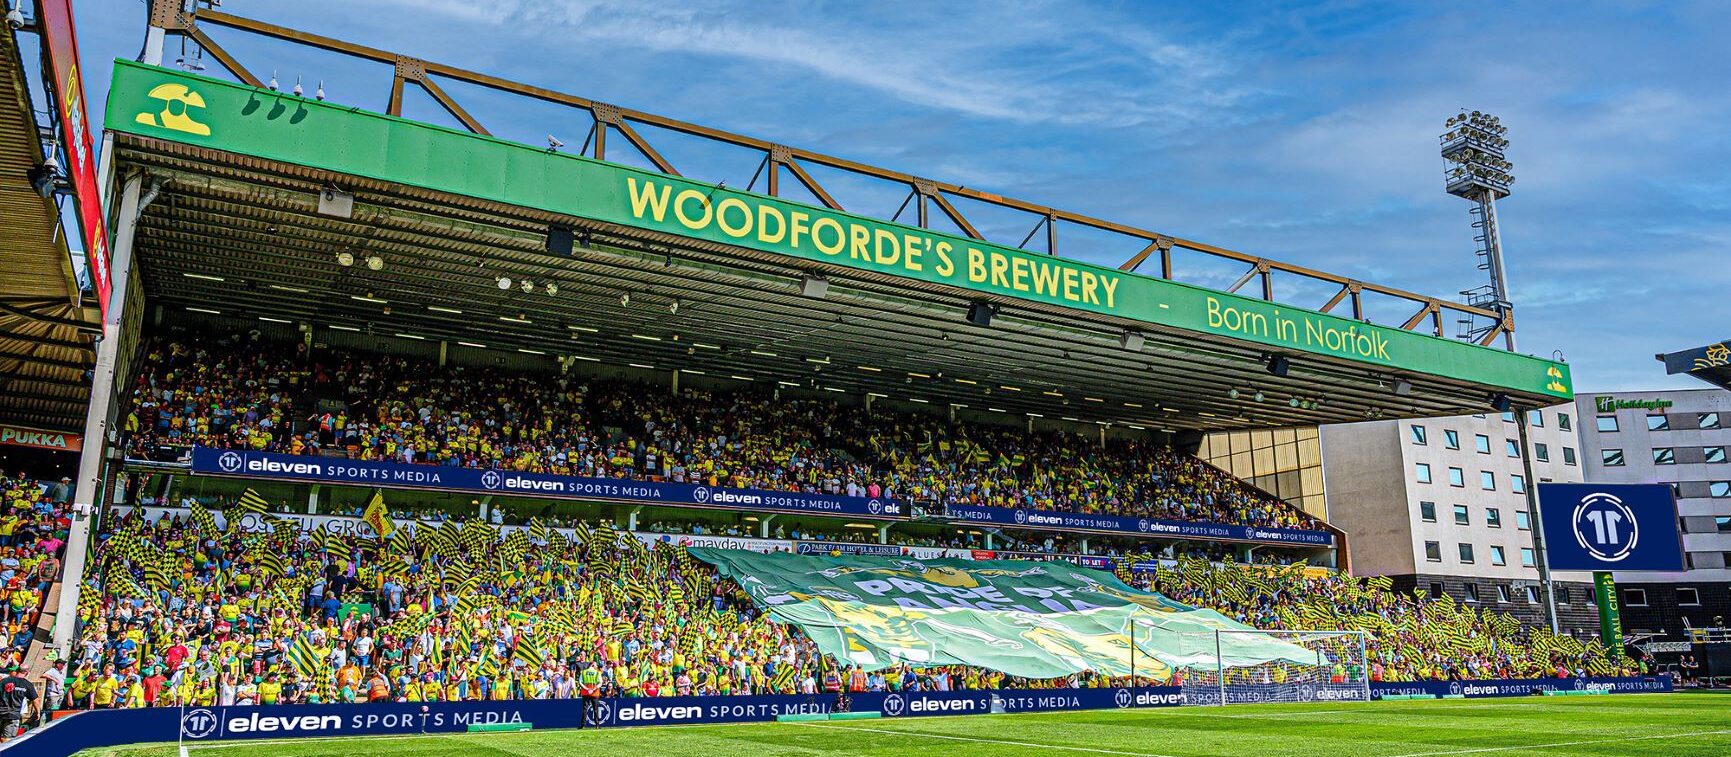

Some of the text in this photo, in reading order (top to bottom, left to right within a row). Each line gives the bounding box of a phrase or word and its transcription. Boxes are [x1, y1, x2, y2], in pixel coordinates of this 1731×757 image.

[627, 178, 954, 277] WOODFORDE'S
[968, 248, 1119, 308] BREWERY
[1207, 297, 1268, 337] Born
[1275, 310, 1298, 343] in
[1305, 317, 1391, 361] Norfolk
[1, 428, 66, 447] PUKKA
[249, 458, 321, 475] eleven
[327, 466, 389, 480] SPORTS
[394, 470, 441, 484] MEDIA
[506, 476, 564, 491] eleven
[569, 483, 618, 494] SPORTS
[622, 487, 661, 498] MEDIA
[713, 490, 762, 505] eleven
[765, 496, 806, 508] SPORTS
[809, 500, 841, 510] MEDIA
[964, 511, 992, 520] MEDIA
[1028, 514, 1062, 525] eleven
[1064, 517, 1095, 527] SPORTS
[1096, 519, 1120, 529] MEDIA
[1150, 524, 1180, 533] eleven
[1182, 527, 1207, 535] SPORTS
[1208, 528, 1230, 536] MEDIA
[1256, 530, 1282, 539] eleven
[1283, 532, 1305, 541] SPORTS
[1611, 614, 1623, 639] BALL
[1316, 687, 1358, 700] eleven
[1463, 684, 1499, 695] eleven
[1501, 685, 1531, 694] SPORTS
[1586, 681, 1616, 691] eleven
[1617, 682, 1643, 690] SPORTS
[1644, 681, 1665, 689] MEDIA
[910, 696, 974, 711] eleven
[1038, 696, 1080, 708] MEDIA
[1136, 692, 1187, 705] eleven
[619, 703, 701, 720] eleven
[710, 704, 779, 718] SPORTS
[228, 712, 342, 732] eleven
[352, 713, 444, 728] SPORTS
[453, 710, 523, 726] MEDIA
